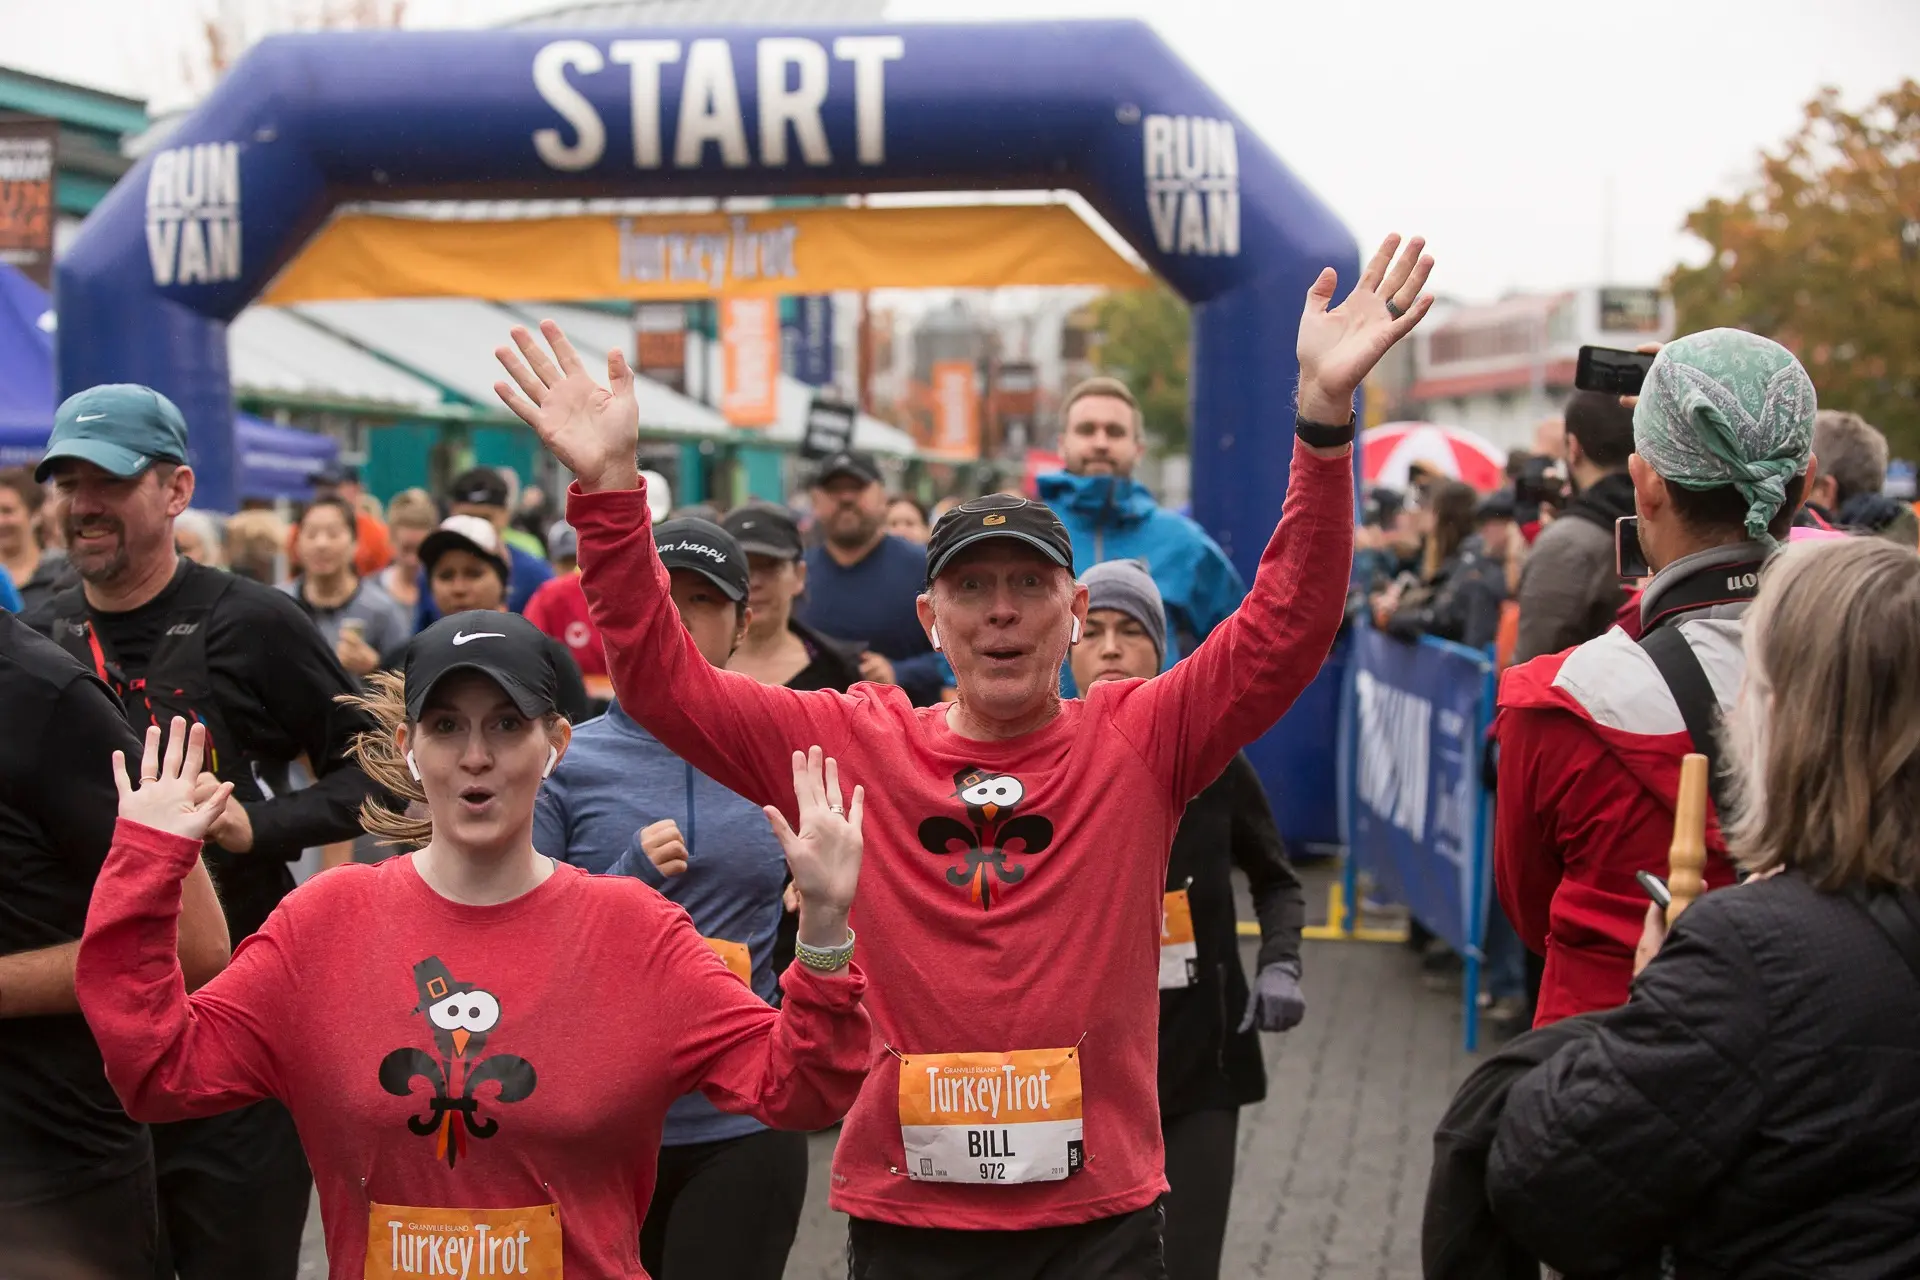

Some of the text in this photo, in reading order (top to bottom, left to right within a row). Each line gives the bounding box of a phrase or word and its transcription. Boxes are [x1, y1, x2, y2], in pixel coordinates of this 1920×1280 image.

[532, 35, 904, 171] START
[1143, 114, 1239, 179] RUN
[146, 141, 240, 208] RUN
[1145, 188, 1241, 257] VAN
[144, 216, 242, 286] VAN
[656, 540, 727, 563] un happy
[943, 1066, 975, 1074] GRANVILLE
[967, 1129, 1016, 1158] BILL
[1070, 1147, 1078, 1166] BLACK
[979, 1163, 1006, 1180] 972
[408, 1222, 444, 1232] GRANVILLE
